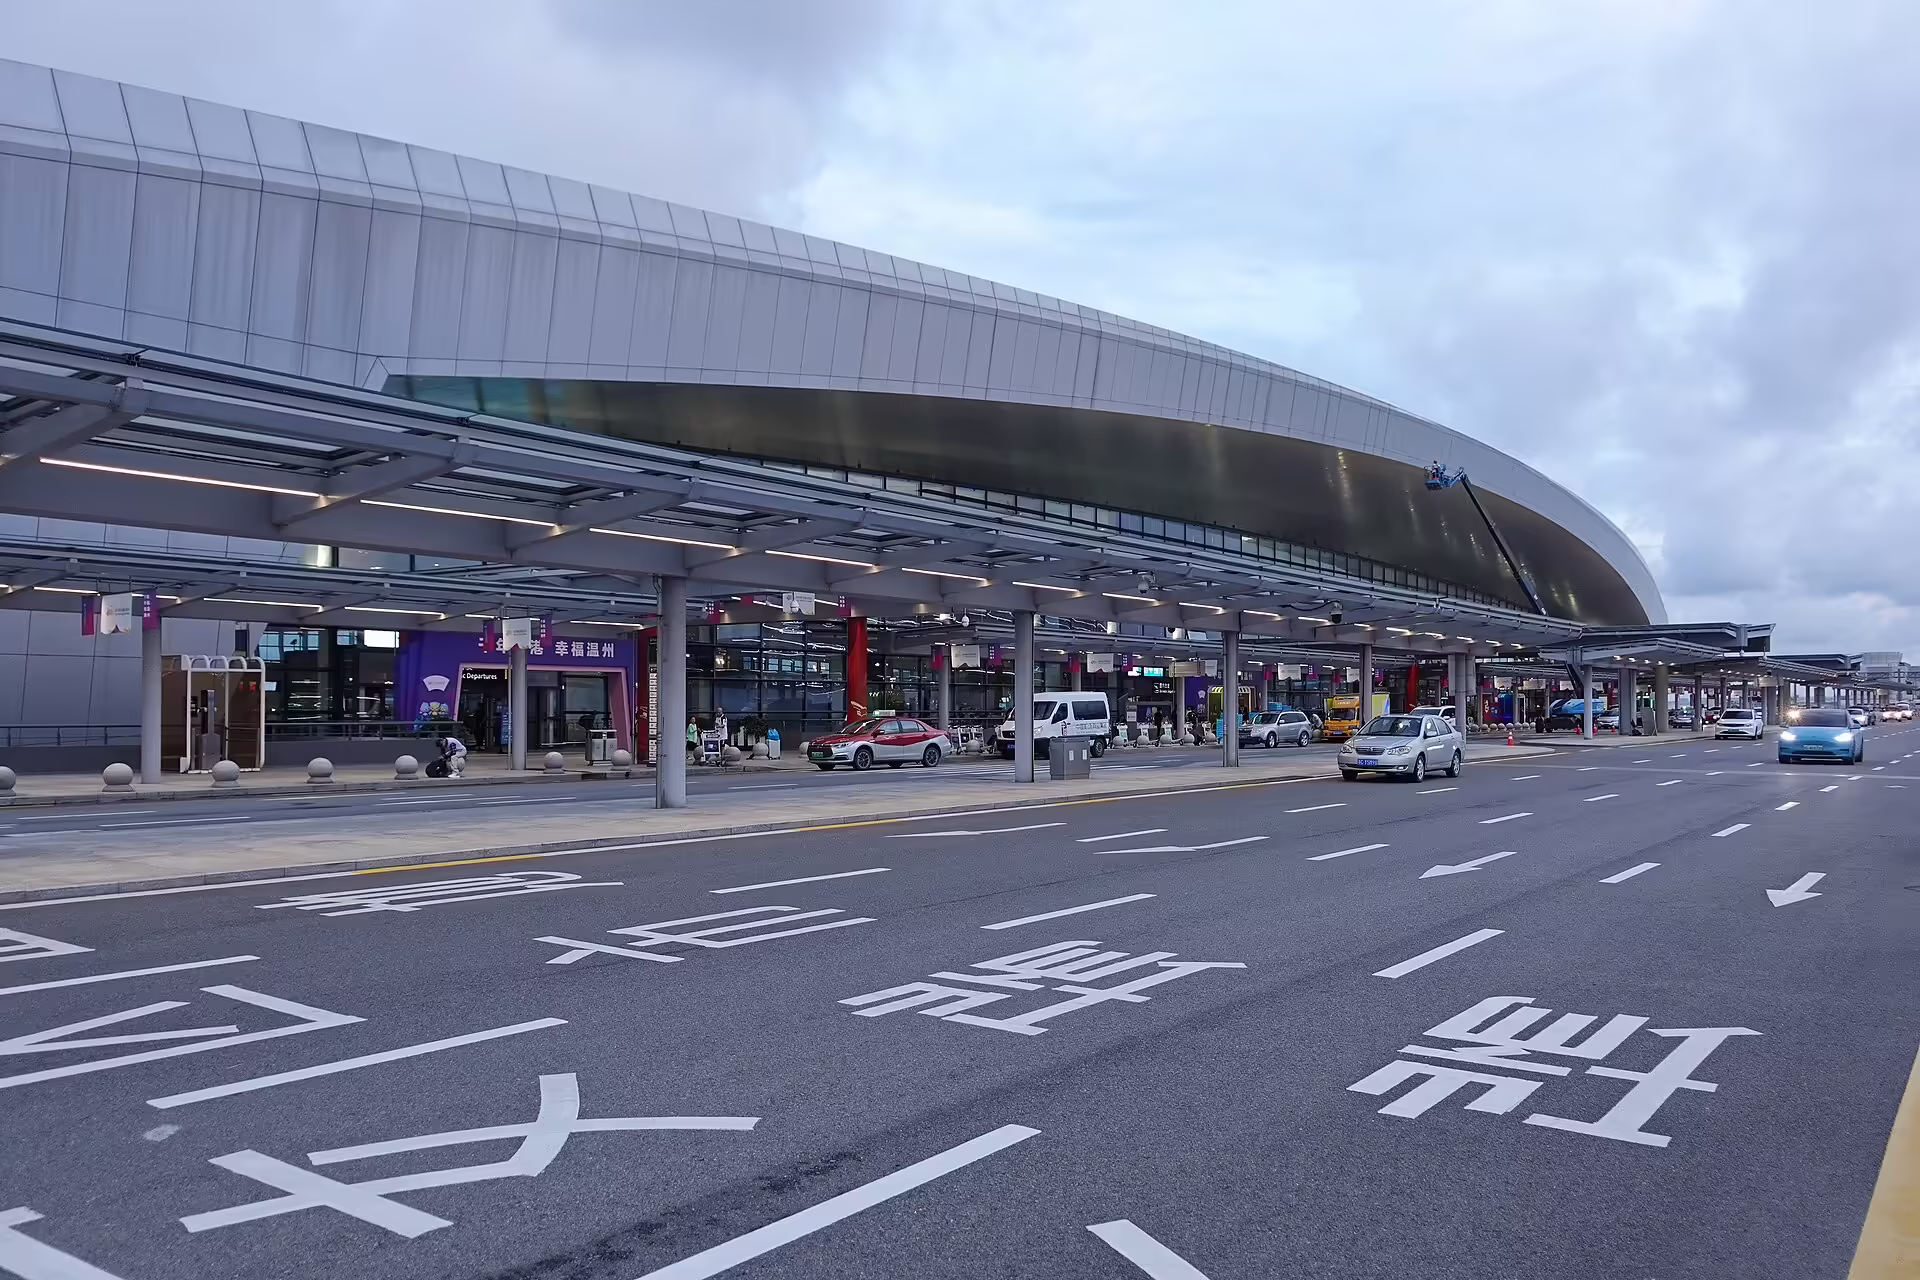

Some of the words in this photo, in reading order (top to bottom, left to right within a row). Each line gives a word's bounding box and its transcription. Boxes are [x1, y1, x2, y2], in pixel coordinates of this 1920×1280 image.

[555, 640, 614, 658] 幸福温州
[467, 672, 498, 681] Departures
